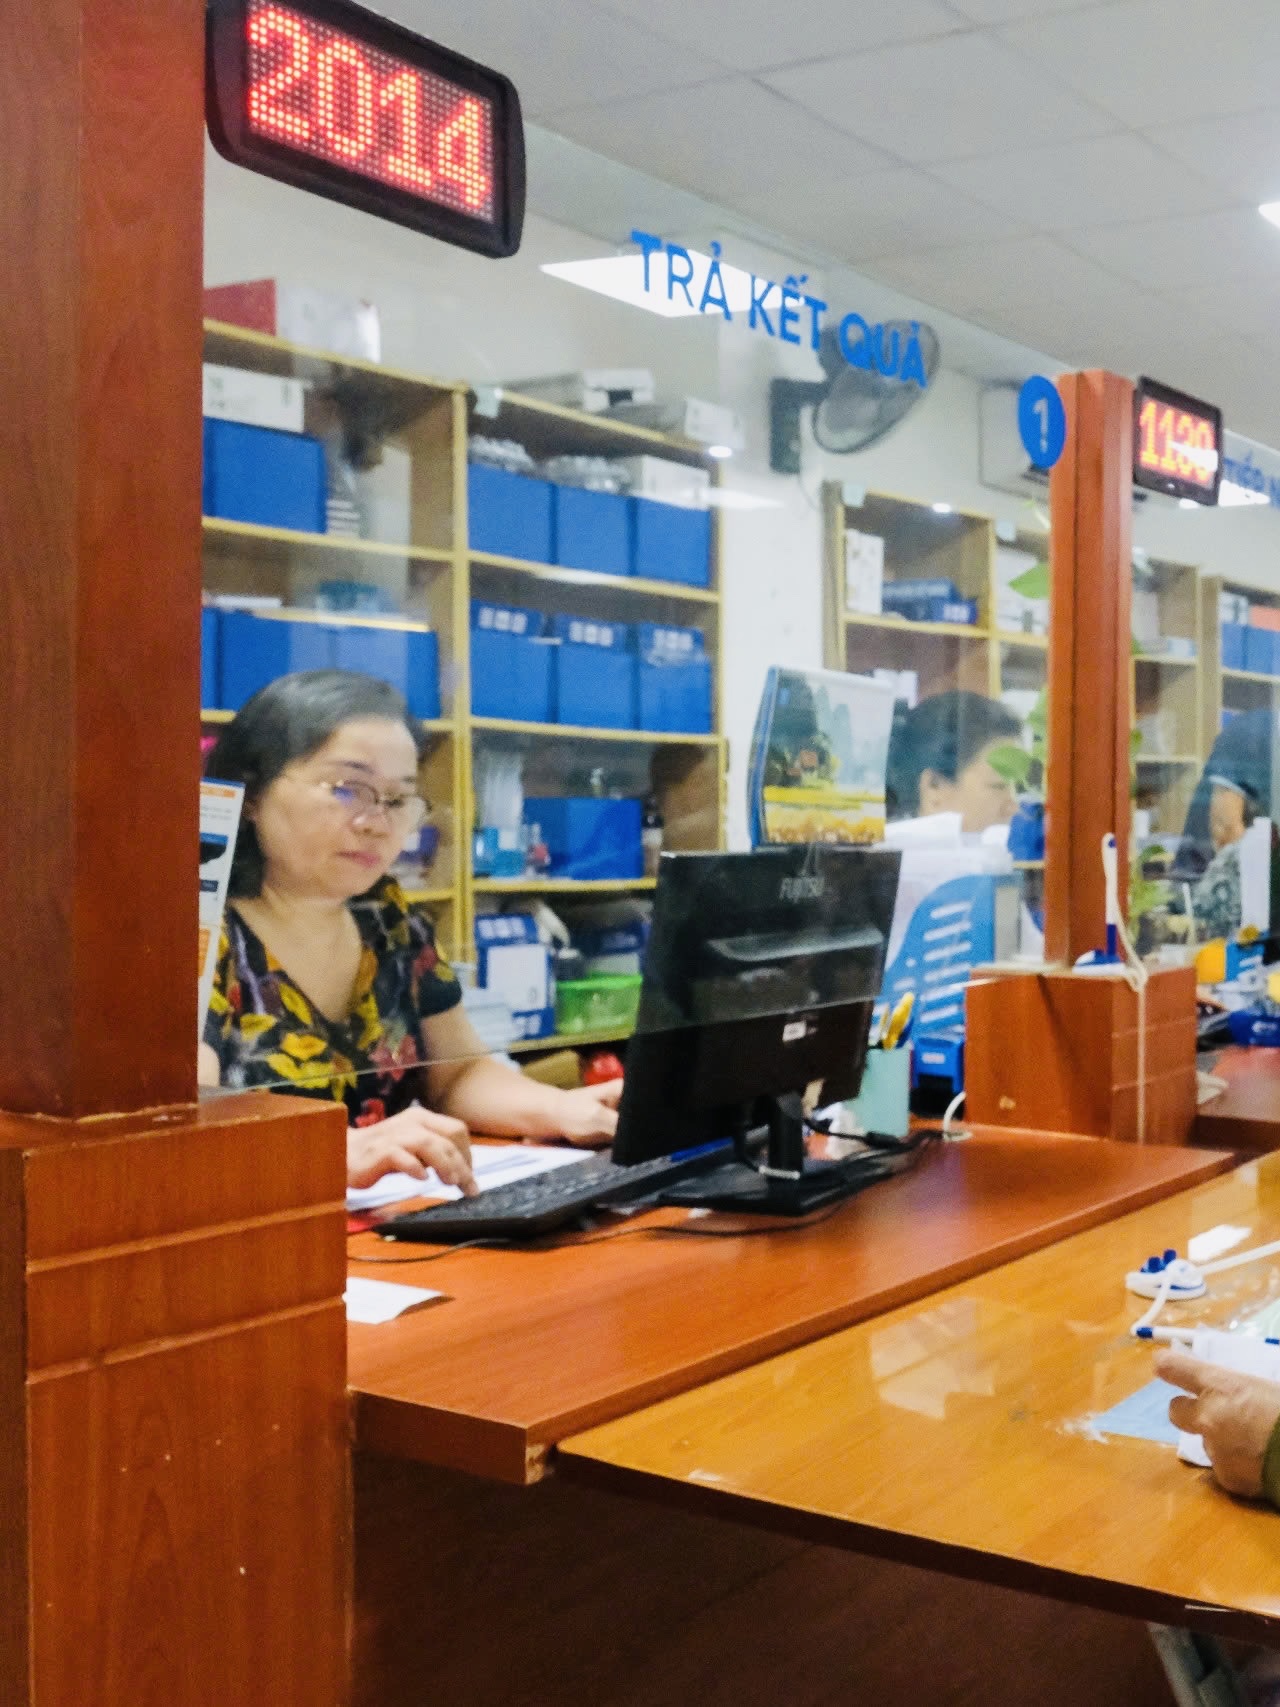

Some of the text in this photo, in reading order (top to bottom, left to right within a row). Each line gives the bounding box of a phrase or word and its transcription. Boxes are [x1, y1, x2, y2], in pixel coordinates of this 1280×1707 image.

[247, 9, 494, 207] 2014
[631, 228, 928, 389] TRẢ KẾT QUẢ
[1032, 397, 1049, 454] 1
